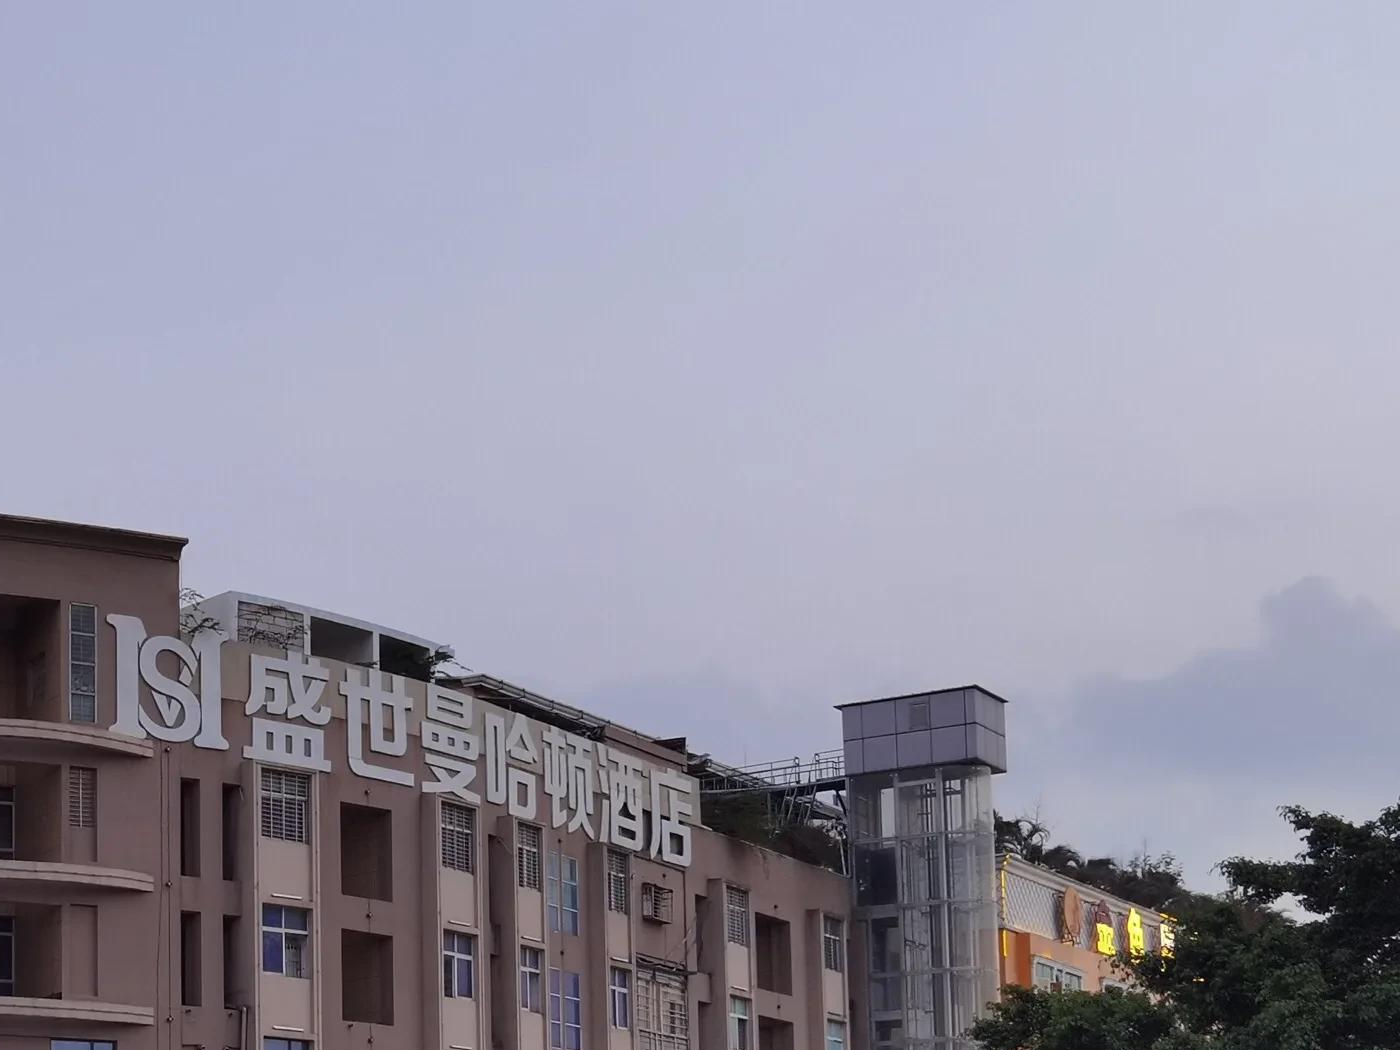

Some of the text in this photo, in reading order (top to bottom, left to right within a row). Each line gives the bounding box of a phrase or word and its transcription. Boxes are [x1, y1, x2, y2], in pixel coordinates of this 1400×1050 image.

[243, 650, 693, 867] 盛世曼哈顿酒店
